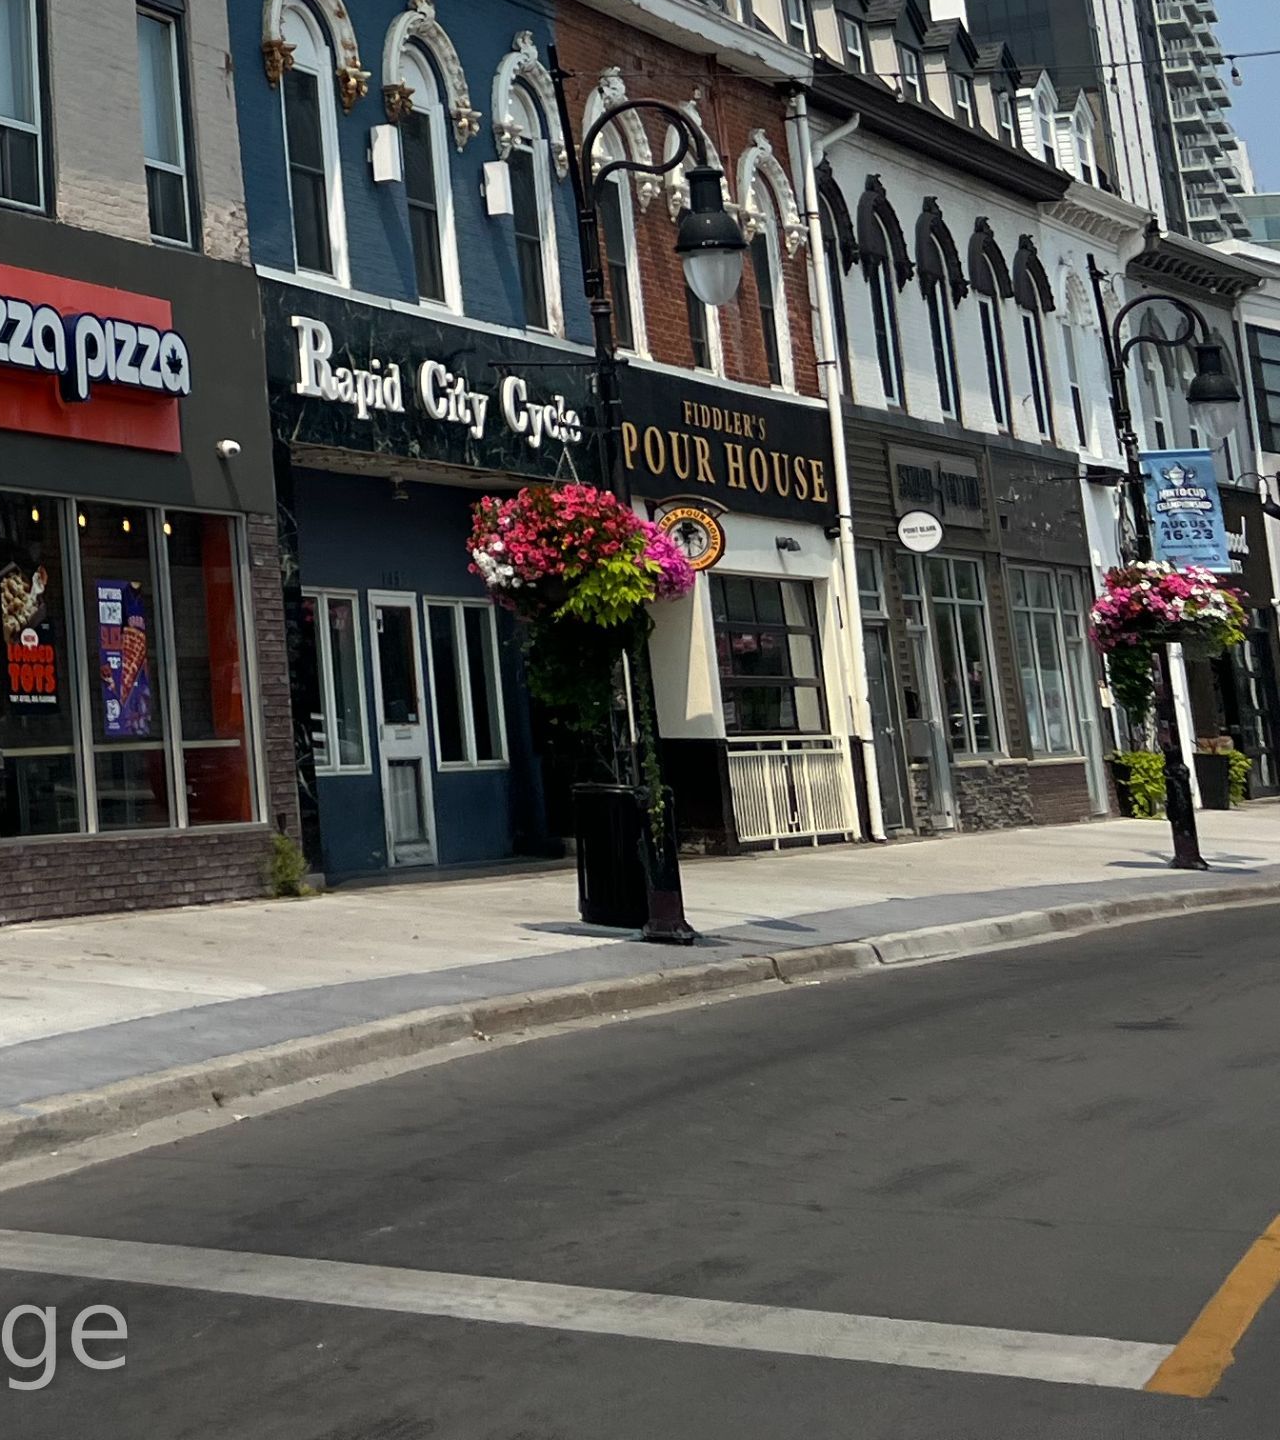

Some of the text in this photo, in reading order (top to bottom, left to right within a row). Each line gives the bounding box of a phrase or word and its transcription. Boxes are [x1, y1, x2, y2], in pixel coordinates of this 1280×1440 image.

[75, 312, 191, 399] pizza
[291, 315, 582, 448] Rapid City Cycle
[683, 401, 766, 440] FIDDLER'S
[621, 422, 715, 484] POUR
[724, 442, 828, 503] HOUSE
[1161, 520, 1215, 528] AUGUST
